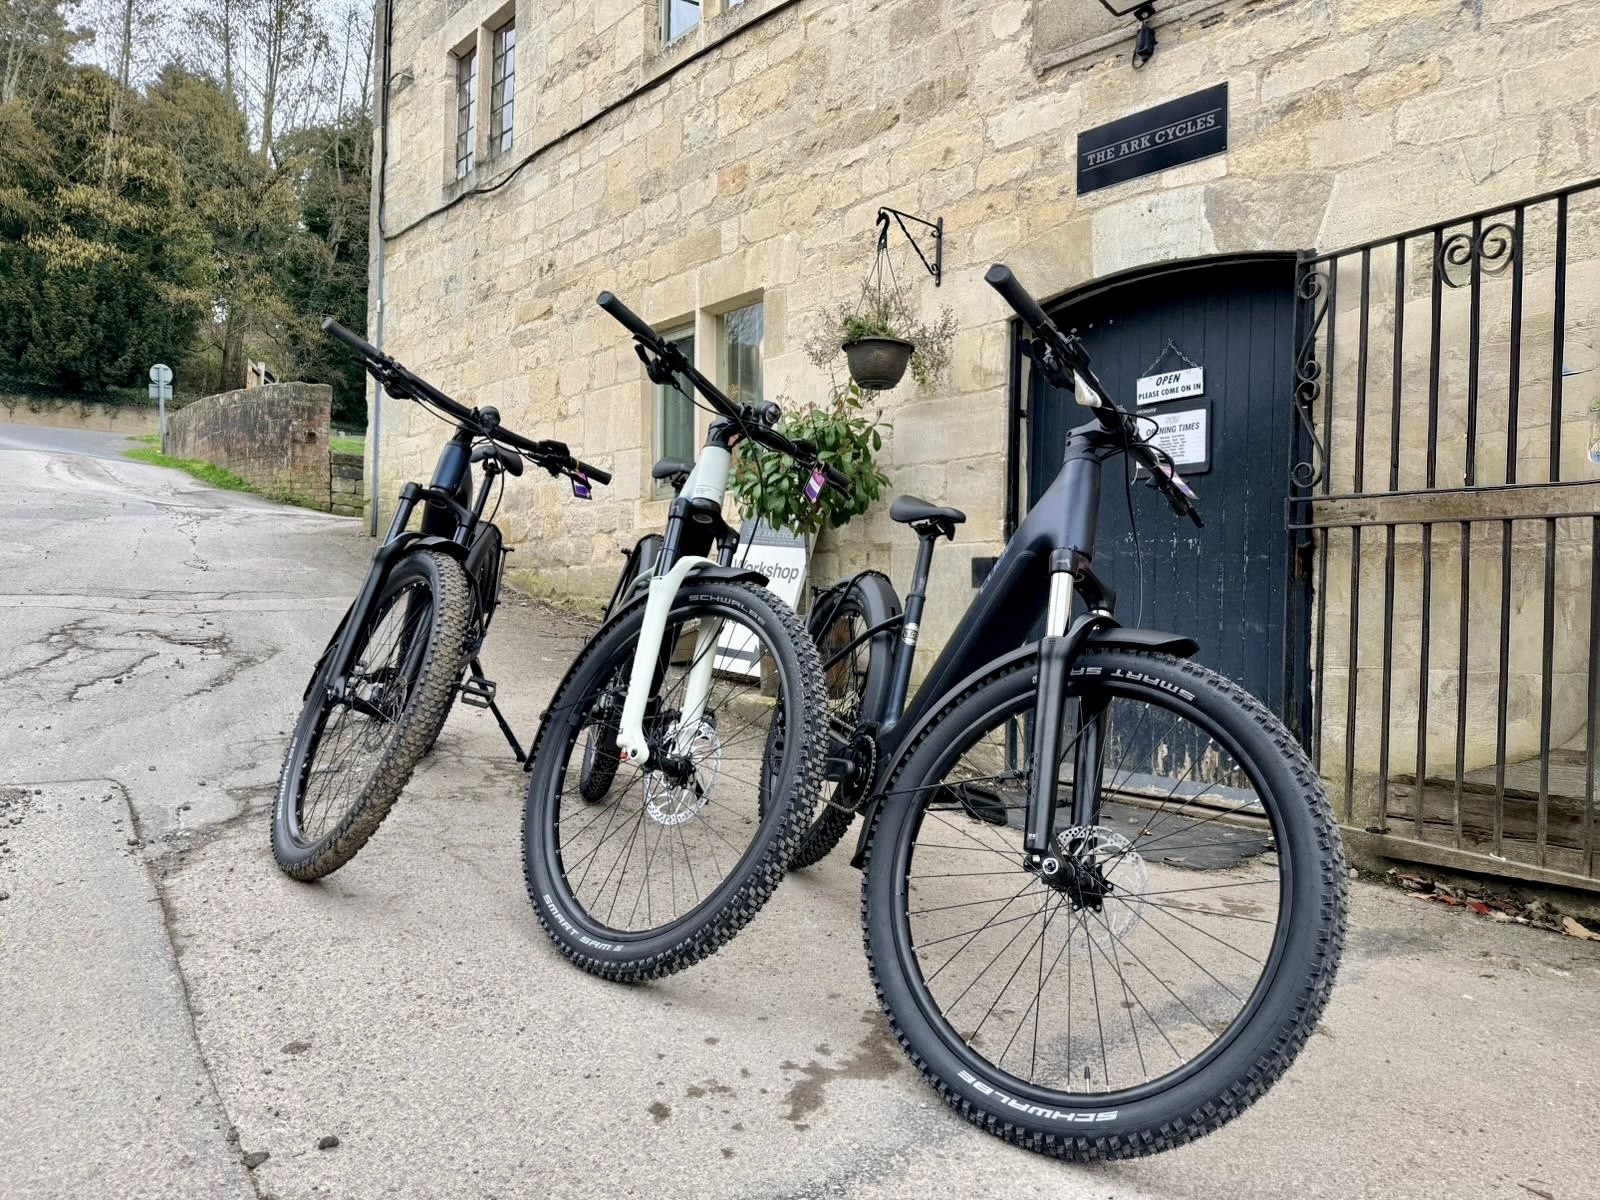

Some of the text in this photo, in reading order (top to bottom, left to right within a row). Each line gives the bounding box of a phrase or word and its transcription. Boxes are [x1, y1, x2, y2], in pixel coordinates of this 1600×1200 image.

[1087, 114, 1216, 166] THE ARK CYCLES
[1138, 391, 1159, 401] PLEASE
[1161, 387, 1179, 396] COME
[1181, 384, 1191, 392] ON
[1156, 373, 1181, 386] OPEN
[1178, 422, 1200, 432] TIMES
[689, 594, 767, 627] SCHWALBE
[1069, 667, 1196, 702] SMART SA
[276, 736, 299, 820] SCHWALBE
[542, 893, 612, 951] SMART SAM
[956, 1069, 1120, 1123] SCHWALBE
